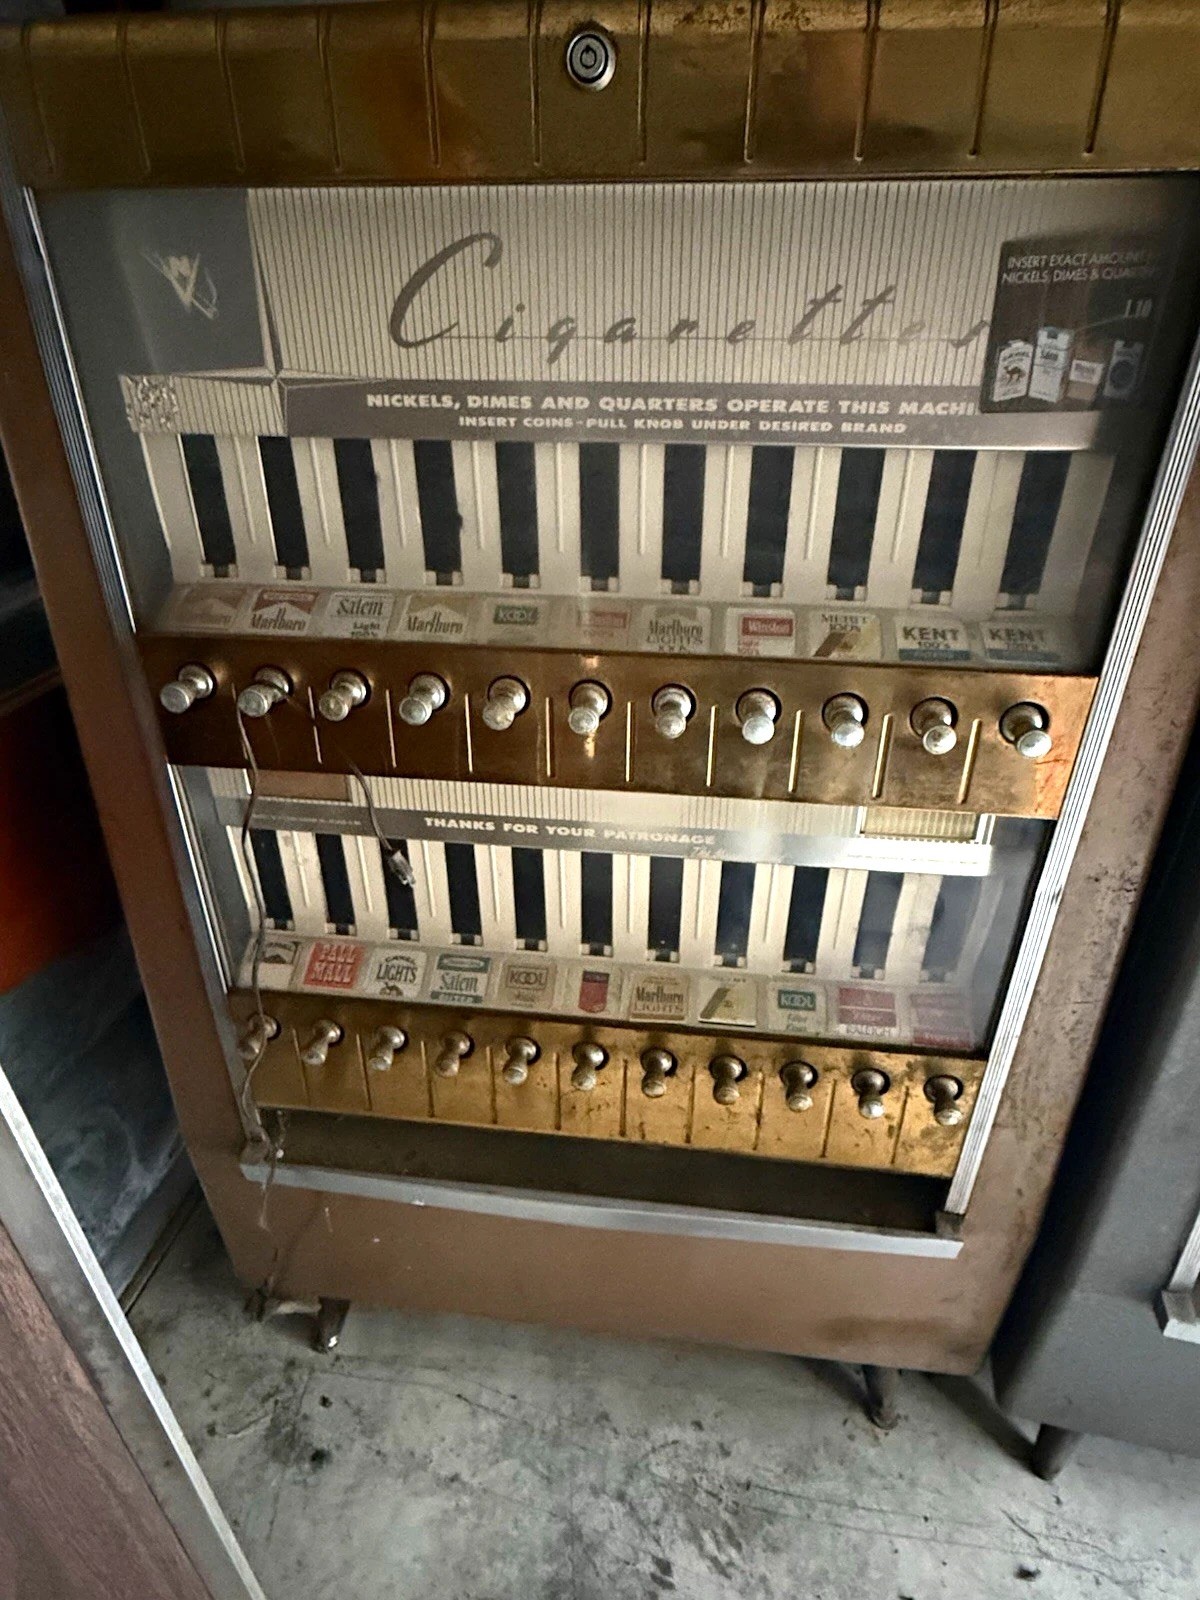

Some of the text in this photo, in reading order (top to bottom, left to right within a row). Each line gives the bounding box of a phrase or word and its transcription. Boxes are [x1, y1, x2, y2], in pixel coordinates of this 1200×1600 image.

[390, 232, 990, 364] Cigarettes
[365, 393, 978, 417] NICKELS, DIMES AND QUARTERS OPERATE THIS MACHI
[458, 415, 517, 428] INSERT
[633, 418, 684, 431] KNOB
[690, 419, 751, 432] UNDER
[758, 420, 834, 433] DESIRED
[840, 421, 908, 435] BRAND
[250, 606, 307, 631] Marlboro
[406, 610, 464, 635] Marlboro
[648, 618, 704, 638] Marlboro
[902, 625, 960, 641] KENT
[988, 627, 1046, 643] KENT
[423, 816, 717, 846] THANKS FOR YOUR PATRONAGE
[375, 963, 419, 985] LIGHTS
[438, 971, 479, 993] Salem
[508, 969, 548, 986] KOOL
[635, 985, 685, 1003] Marlboro
[780, 993, 816, 1008] KOOL
